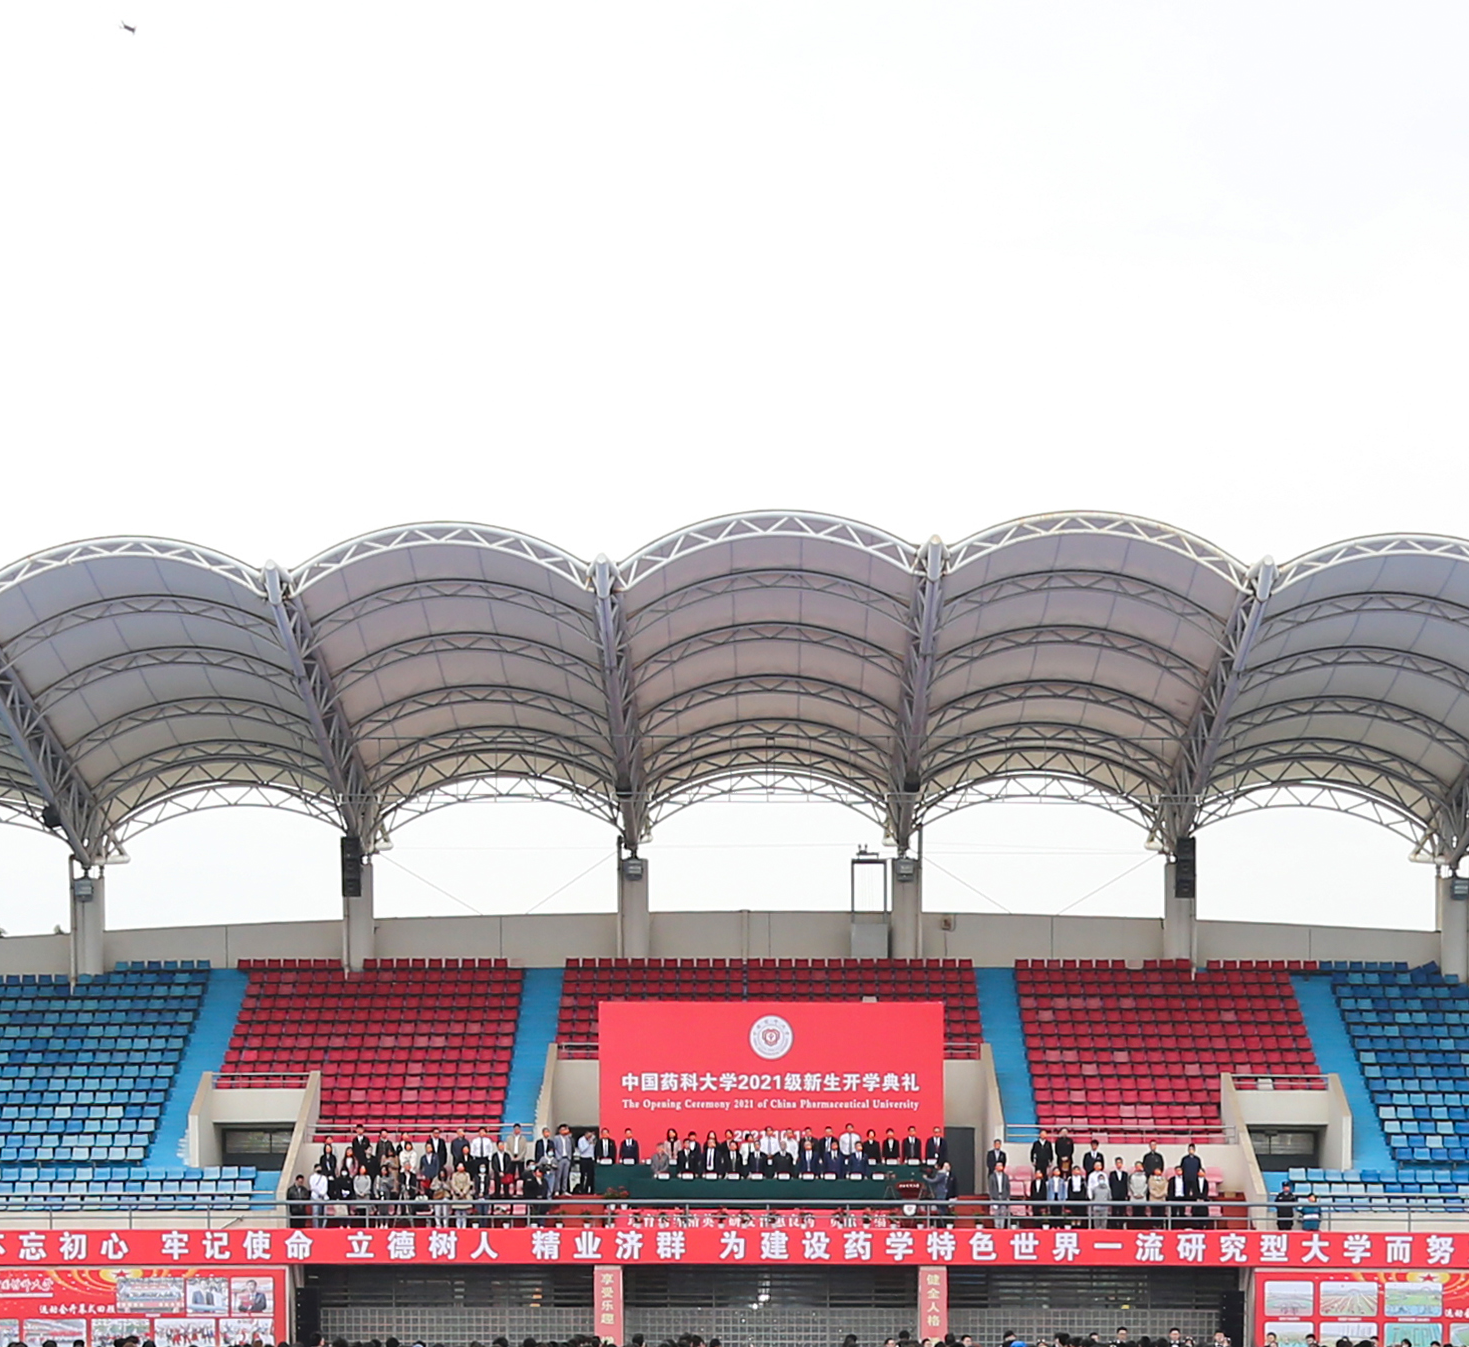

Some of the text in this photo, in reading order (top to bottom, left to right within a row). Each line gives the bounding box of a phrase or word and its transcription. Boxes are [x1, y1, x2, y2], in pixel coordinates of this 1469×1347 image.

[621, 1072, 920, 1092] 中国药科大学2021级新生开学典礼
[622, 1098, 919, 1111] The Opening Ceremony 2021 of China Pharmaceutical University
[161, 1230, 314, 1260] 牢记使命
[346, 1230, 499, 1260] 立德树人
[531, 1230, 687, 1260] 精业济群
[600, 1273, 615, 1325] 享受乐趣
[926, 1274, 941, 1327] 健全人格
